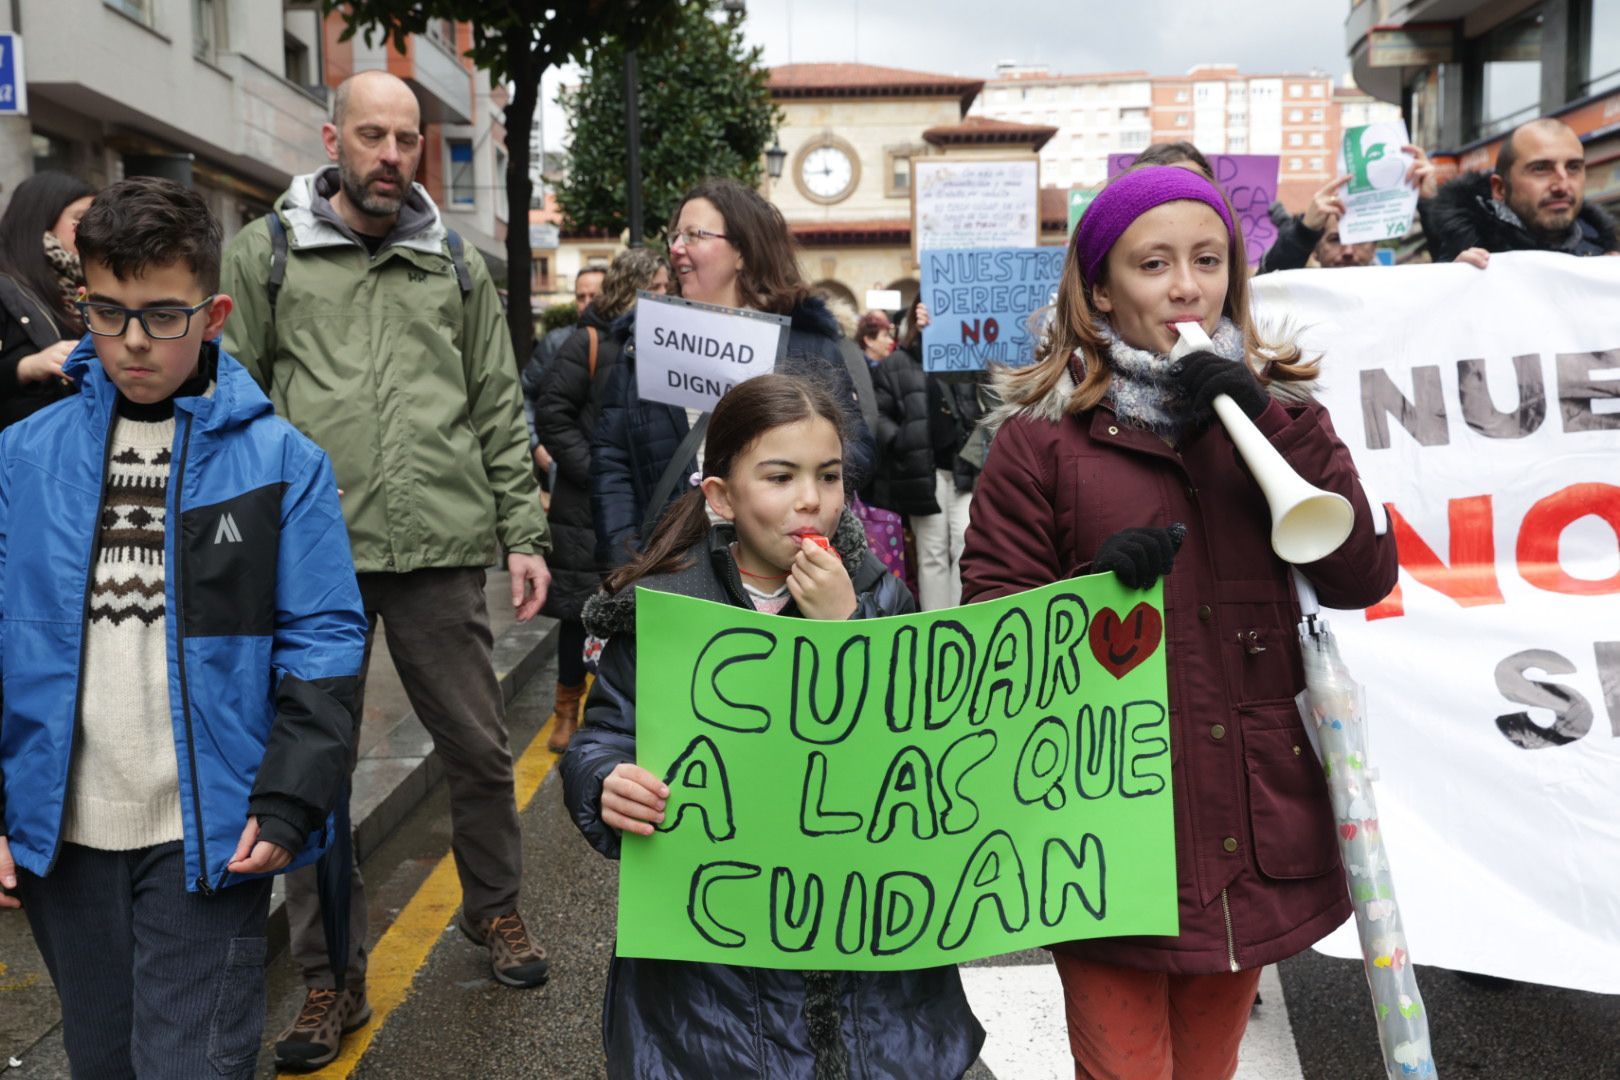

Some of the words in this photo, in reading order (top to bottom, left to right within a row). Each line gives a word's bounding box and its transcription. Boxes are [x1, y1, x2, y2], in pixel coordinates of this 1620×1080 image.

[931, 251, 1065, 284] NUESTRO
[1386, 222, 1406, 236] YA
[653, 327, 755, 364] SANIDAD
[961, 317, 999, 345] NO
[1365, 482, 1620, 622] NO
[690, 592, 1090, 745] CUIDAR
[653, 734, 737, 843] A
[800, 728, 998, 843] LAS
[1013, 699, 1169, 811] QUE
[686, 828, 1107, 957] CUIDAN
